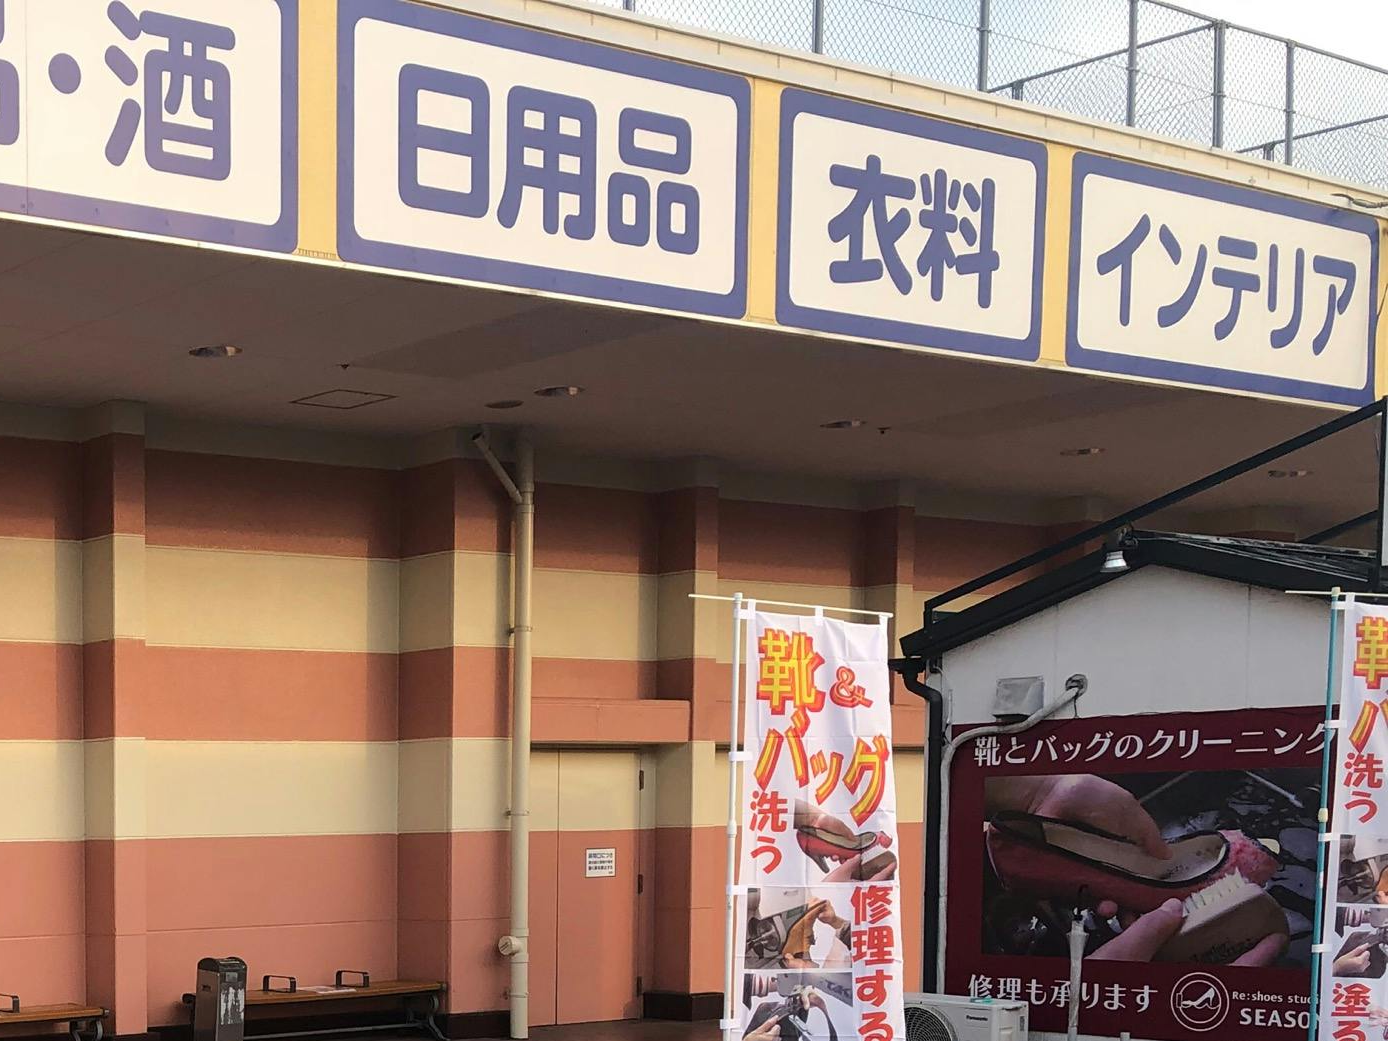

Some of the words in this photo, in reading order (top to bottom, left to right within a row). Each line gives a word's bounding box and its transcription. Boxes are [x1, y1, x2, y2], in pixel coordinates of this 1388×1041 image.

[398, 63, 700, 255] 日用品
[828, 155, 1000, 309] 衣料
[1097, 213, 1356, 356] インテリア
[754, 704, 890, 827] バッグ
[1344, 753, 1383, 823] 洗う
[750, 790, 788, 874] 洗う
[968, 974, 1158, 1012] 修理も承ります
[1232, 991, 1283, 1003] Re:shoes
